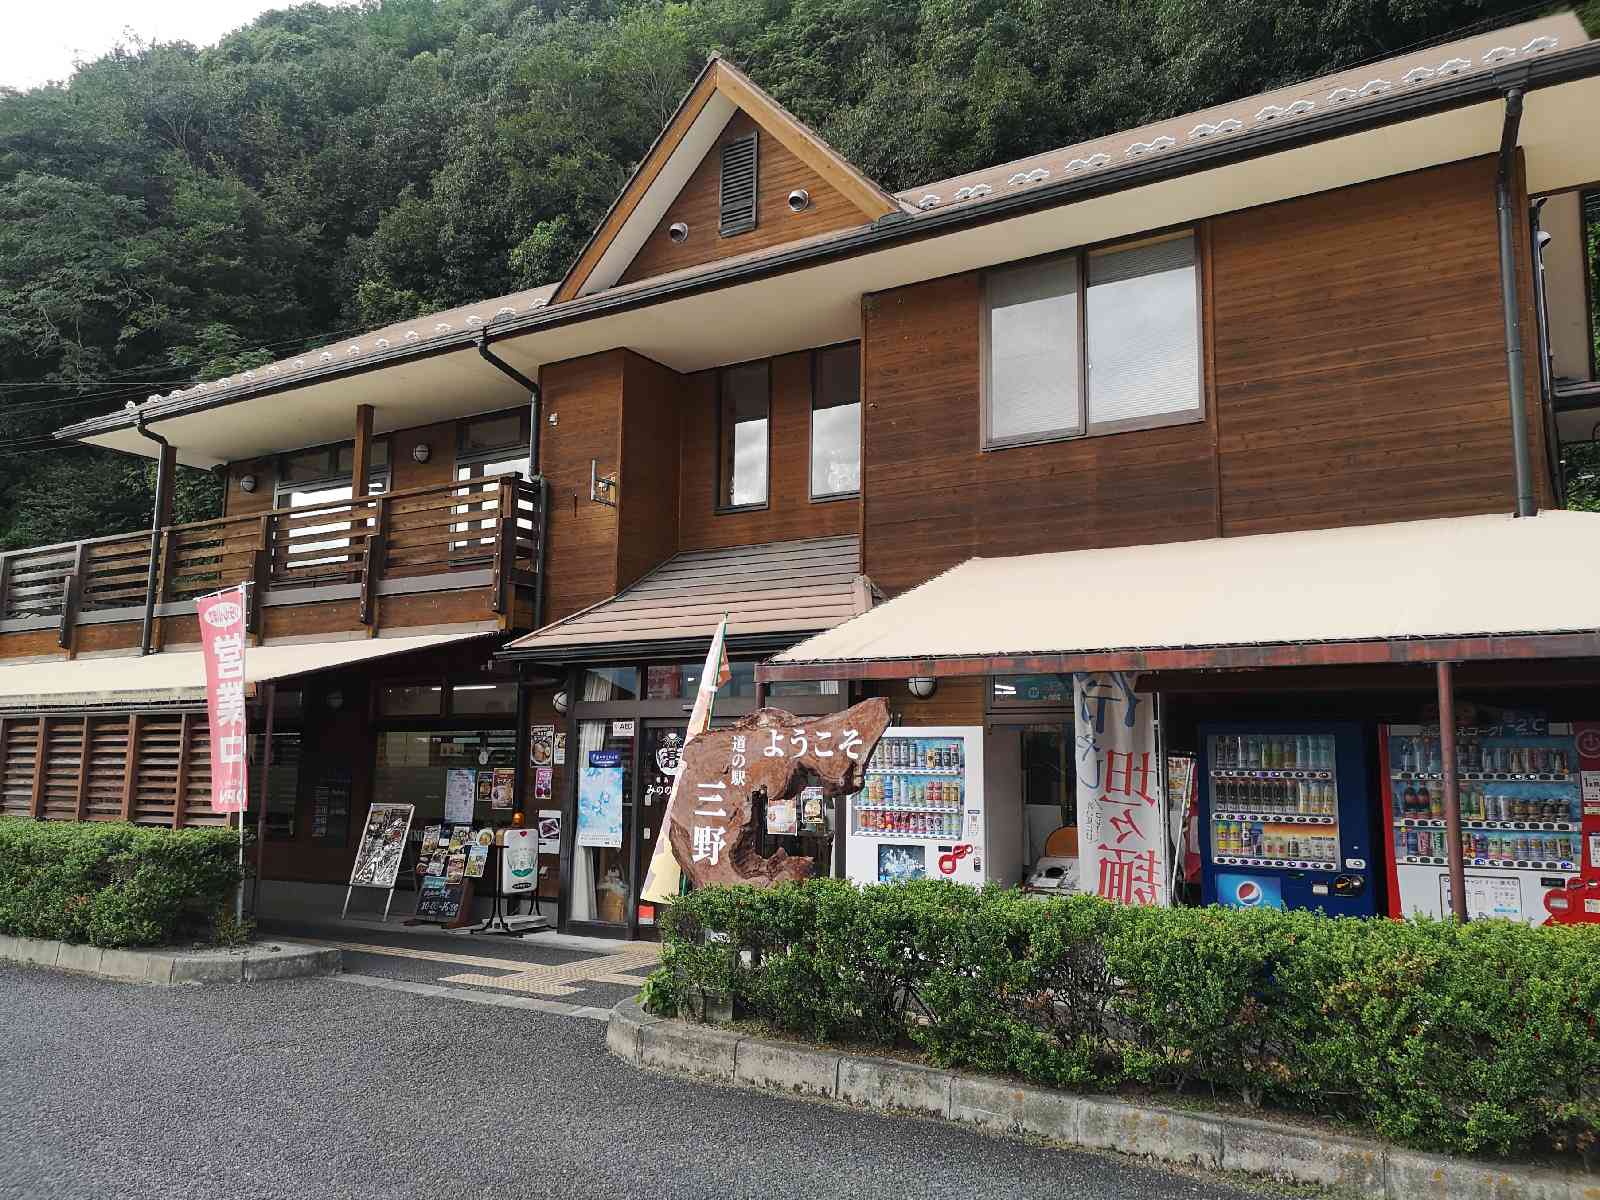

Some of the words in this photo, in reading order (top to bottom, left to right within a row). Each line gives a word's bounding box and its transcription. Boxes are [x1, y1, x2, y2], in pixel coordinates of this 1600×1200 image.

[213, 632, 246, 777] 営業中
[619, 723, 633, 731] AED
[763, 728, 863, 760] ようこそ
[730, 735, 747, 787] 道の駅
[646, 784, 672, 796] みのの
[691, 779, 728, 867] 三野
